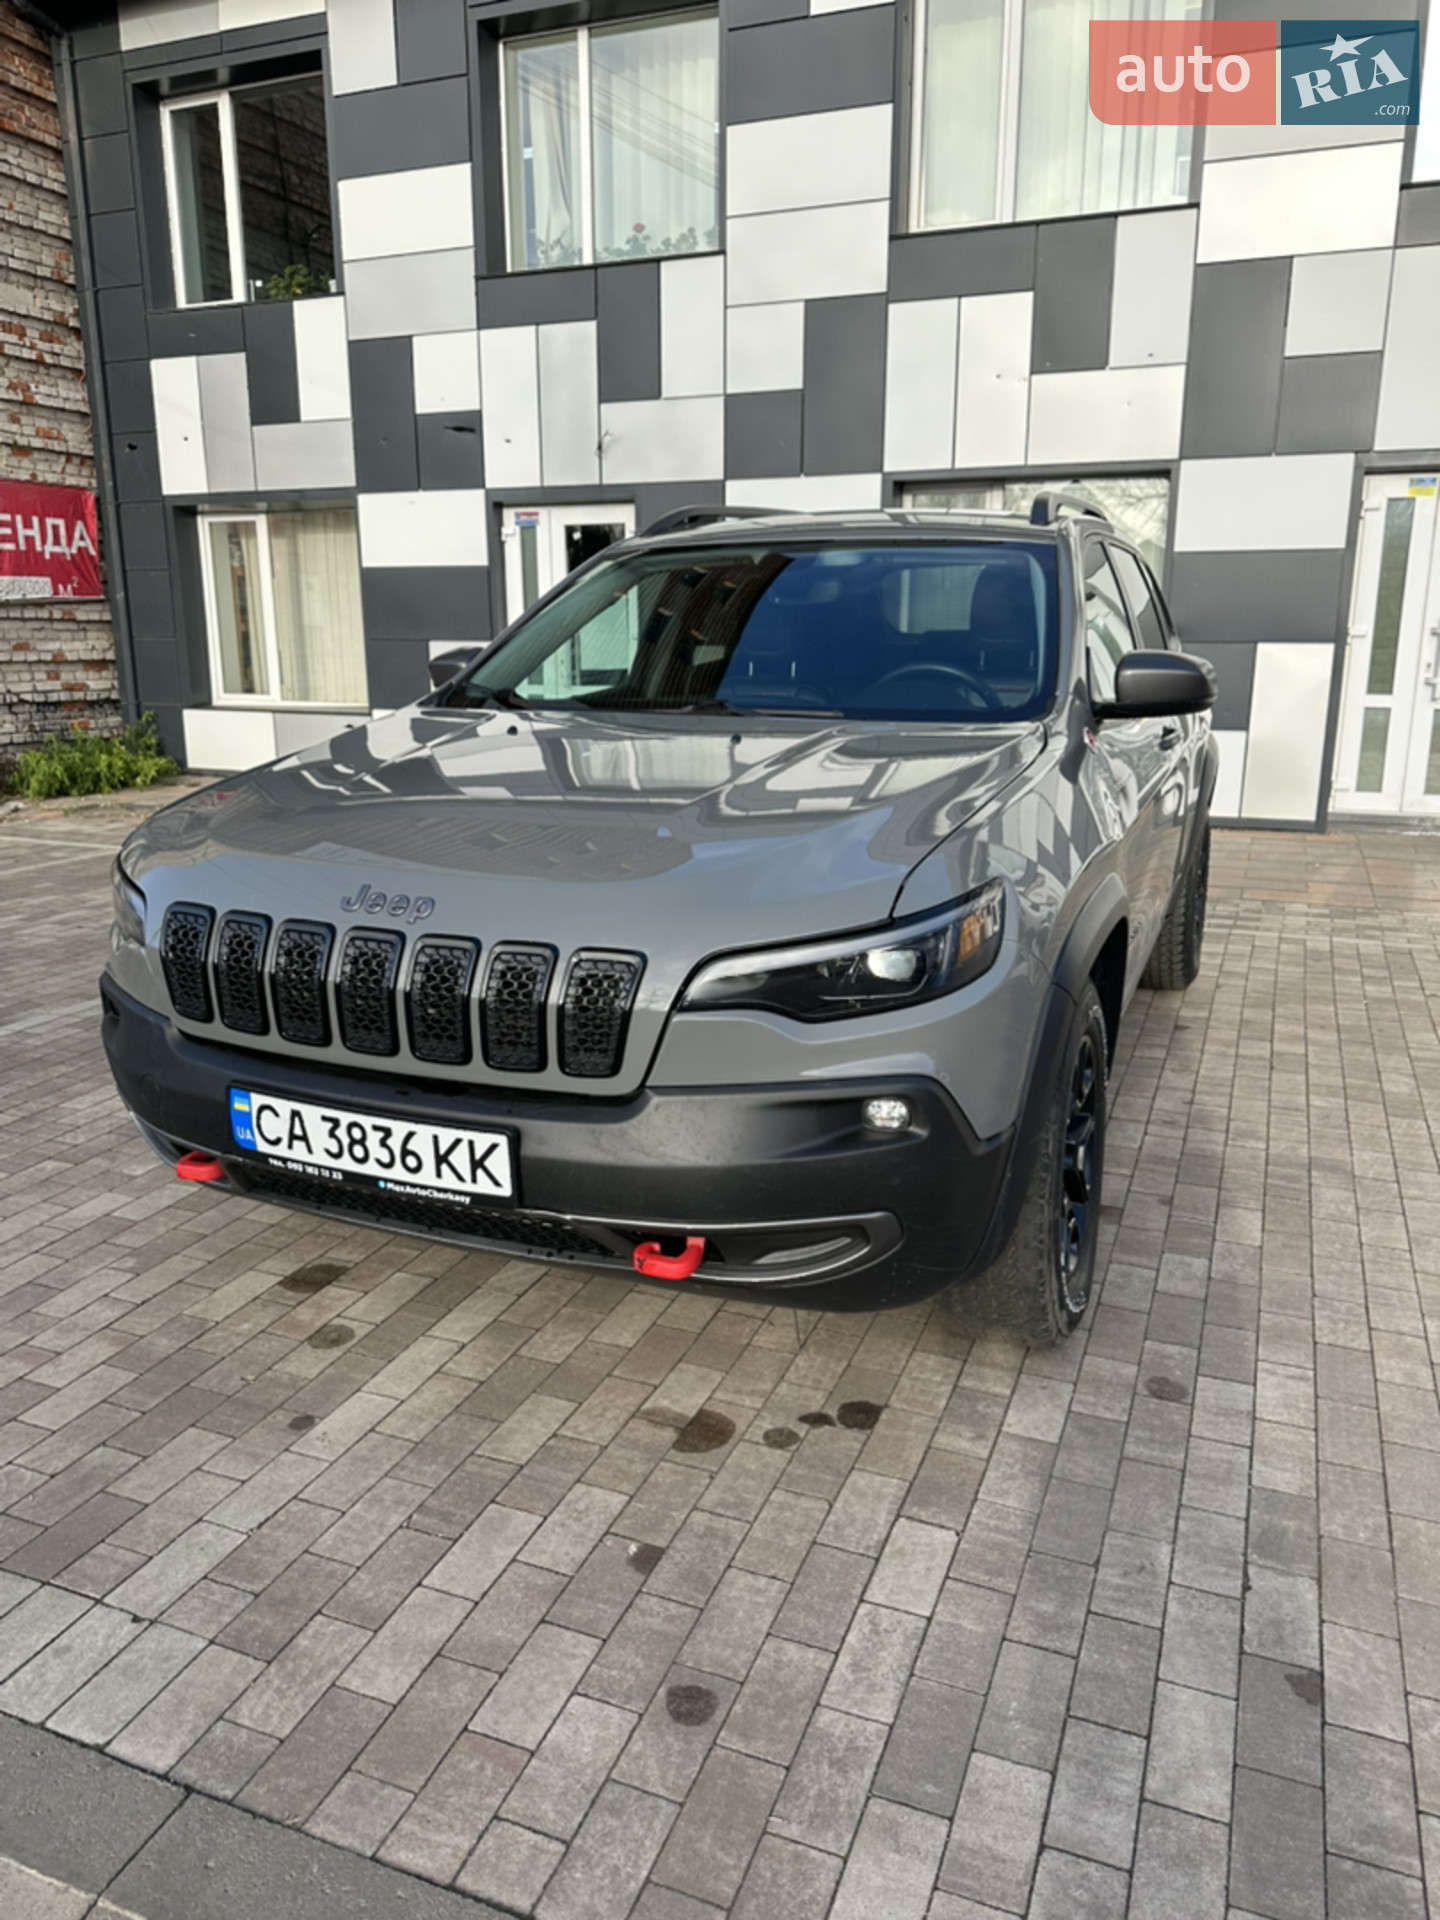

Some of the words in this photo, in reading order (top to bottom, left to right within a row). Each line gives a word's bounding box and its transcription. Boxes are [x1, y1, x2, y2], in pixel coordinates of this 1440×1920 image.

[340, 883, 436, 925] Jeep
[236, 1126, 254, 1141] UA
[255, 1103, 314, 1155] CA
[321, 1115, 424, 1175] 3836
[432, 1134, 504, 1189] KK
